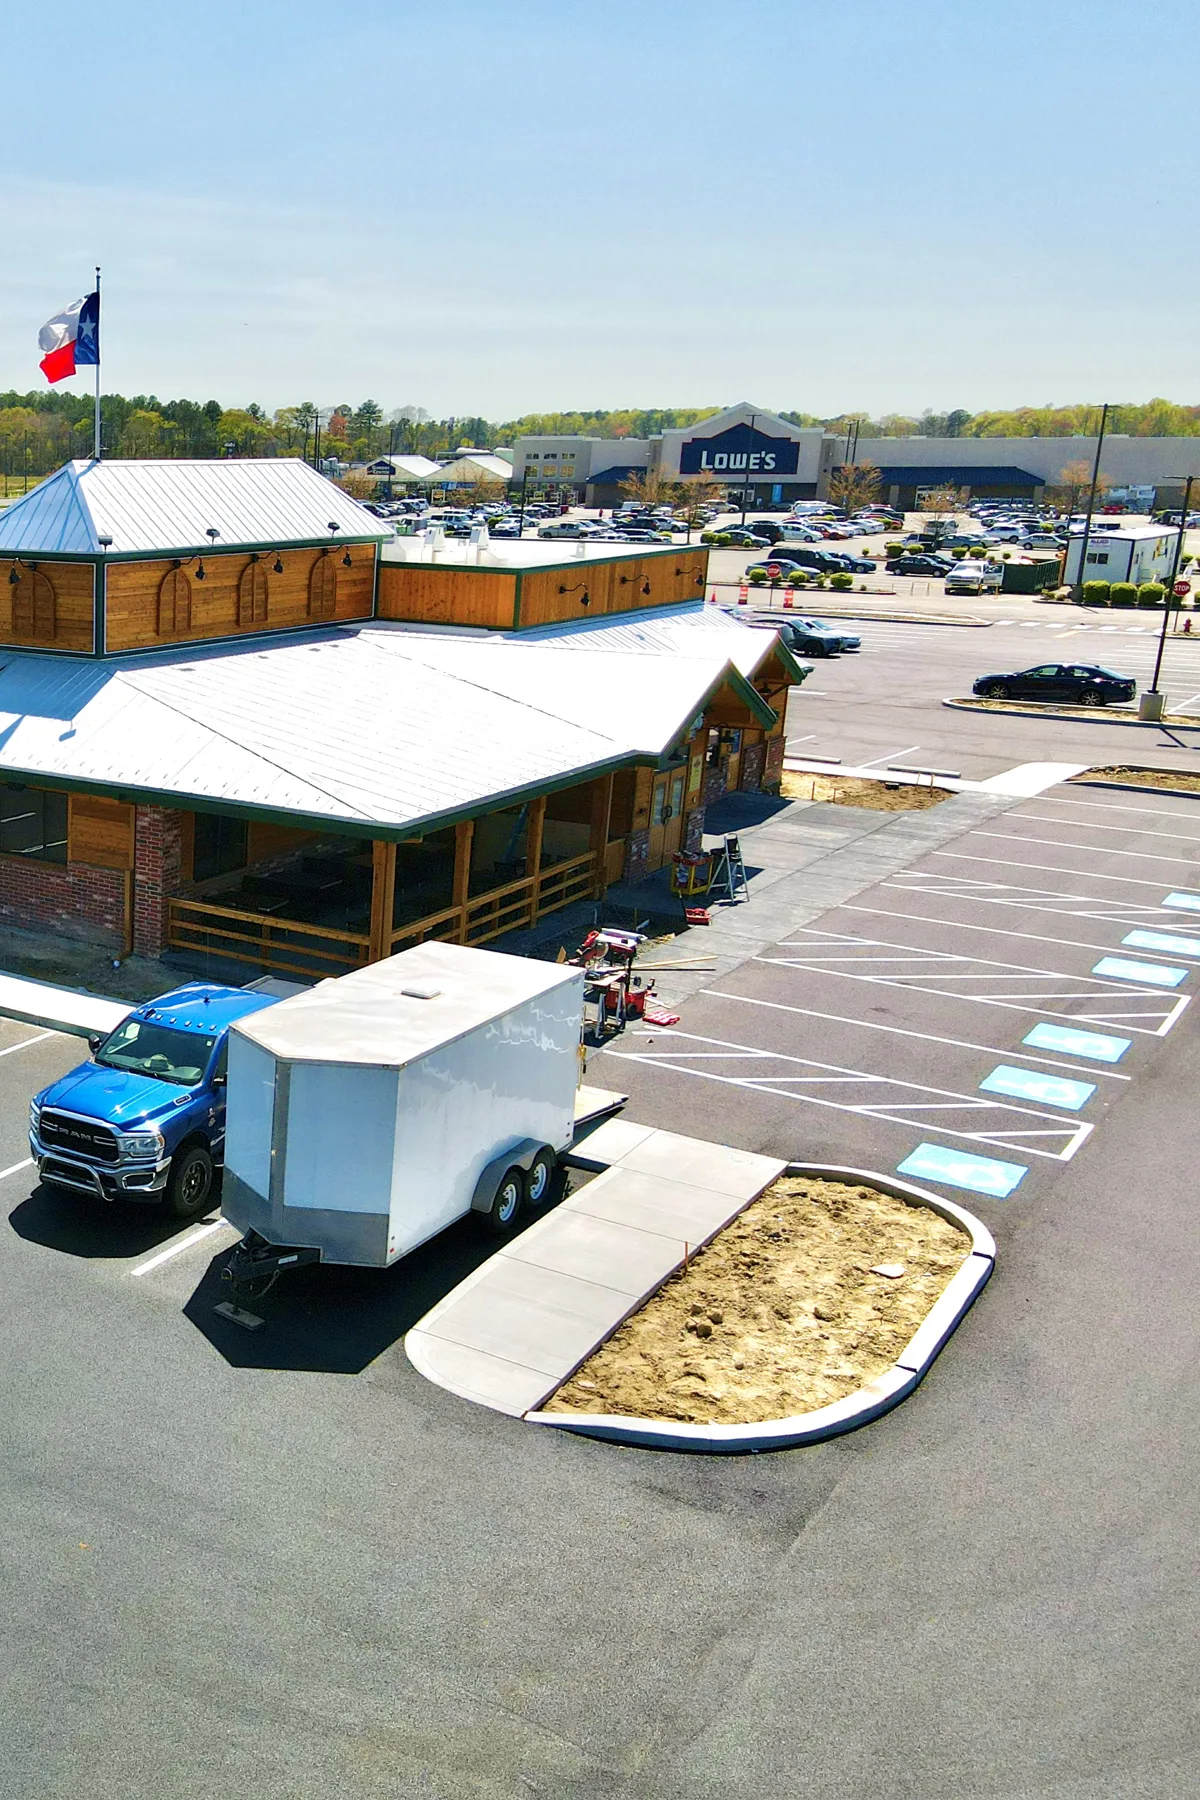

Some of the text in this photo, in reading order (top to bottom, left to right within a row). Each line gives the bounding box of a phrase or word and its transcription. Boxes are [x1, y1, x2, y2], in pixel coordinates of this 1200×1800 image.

[701, 450, 776, 470] LOWE'S
[1174, 584, 1190, 592] STOP
[59, 1127, 92, 1141] RAM
